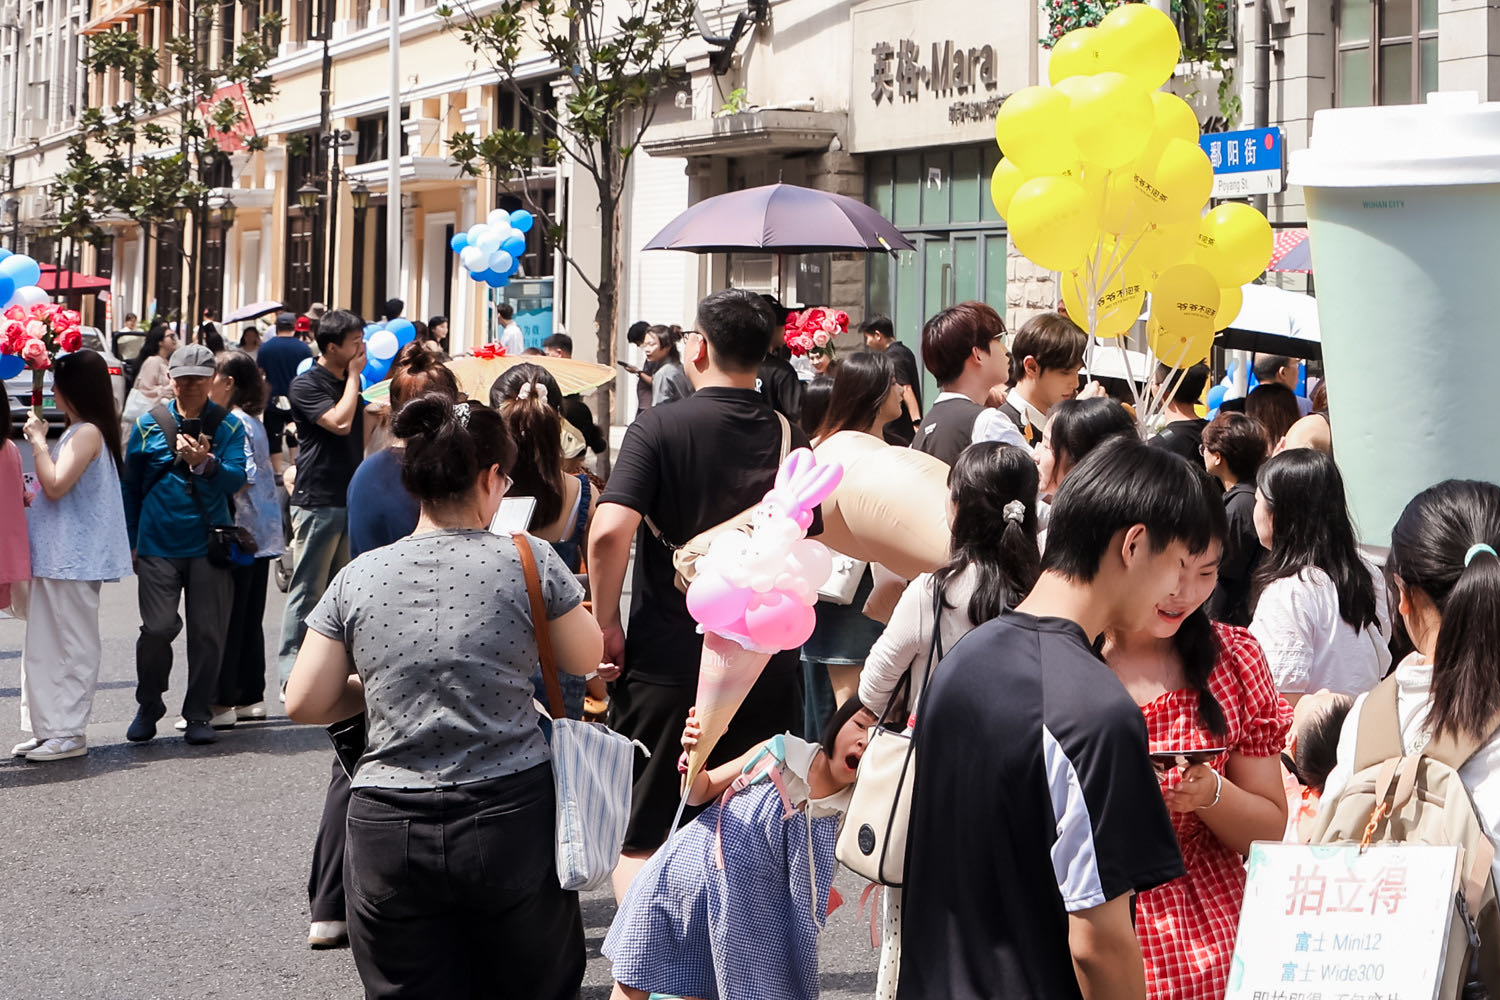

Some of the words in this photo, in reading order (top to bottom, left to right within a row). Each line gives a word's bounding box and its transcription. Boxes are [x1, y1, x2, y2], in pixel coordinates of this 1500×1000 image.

[1210, 137, 1257, 168] 鄱阳街
[1266, 174, 1274, 190] N
[1285, 863, 1408, 917] 拍立得
[1295, 931, 1328, 953] 富士
[1332, 932, 1383, 952] Mini12
[1280, 961, 1316, 983] 富士
[1320, 963, 1385, 983] Wide300
